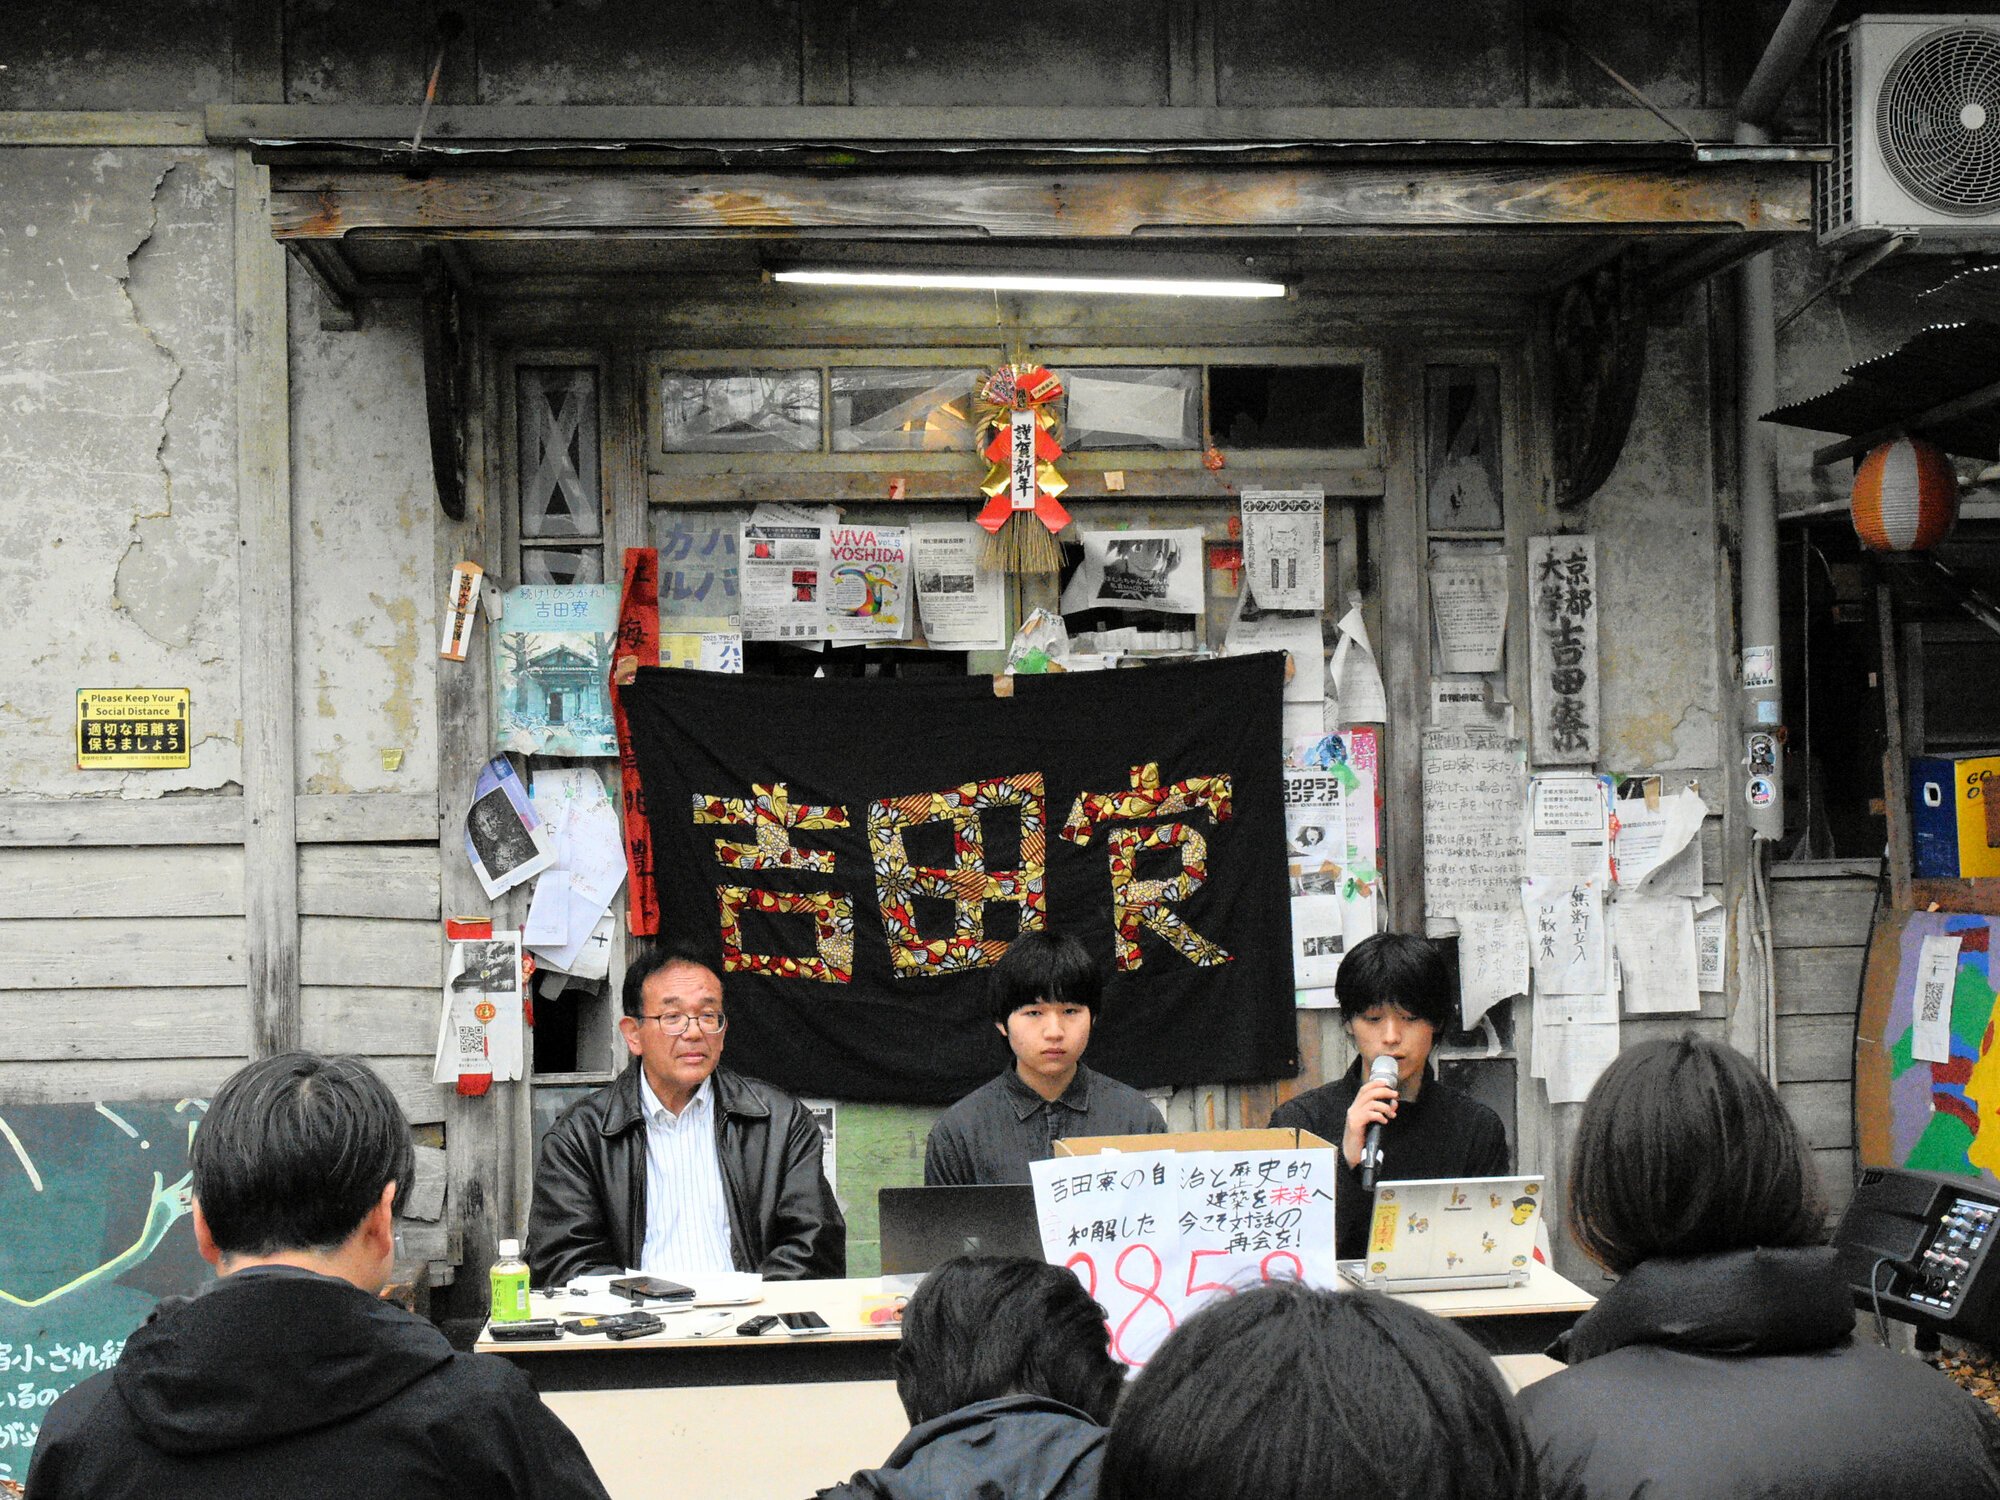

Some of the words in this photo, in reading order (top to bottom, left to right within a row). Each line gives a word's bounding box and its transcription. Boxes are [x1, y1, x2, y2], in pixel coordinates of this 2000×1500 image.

[1013, 423, 1034, 498] 謹賀新年
[829, 529, 877, 546] VIVA
[830, 547, 904, 563] YOSHIDA
[1538, 552, 1565, 622] 大学
[1563, 551, 1592, 619] 京都
[535, 601, 588, 617] 吉田寮
[1549, 615, 1590, 752] 吉田寮
[91, 694, 123, 703] Please
[125, 694, 150, 704] Keep
[152, 694, 175, 703] Your
[96, 707, 125, 716] Social
[128, 707, 170, 716] Distance
[88, 722, 178, 736] 適切な距離を
[88, 737, 178, 751] 保ちましょう
[1569, 884, 1590, 965] 無断立入
[1067, 1212, 1156, 1247] 和解した
